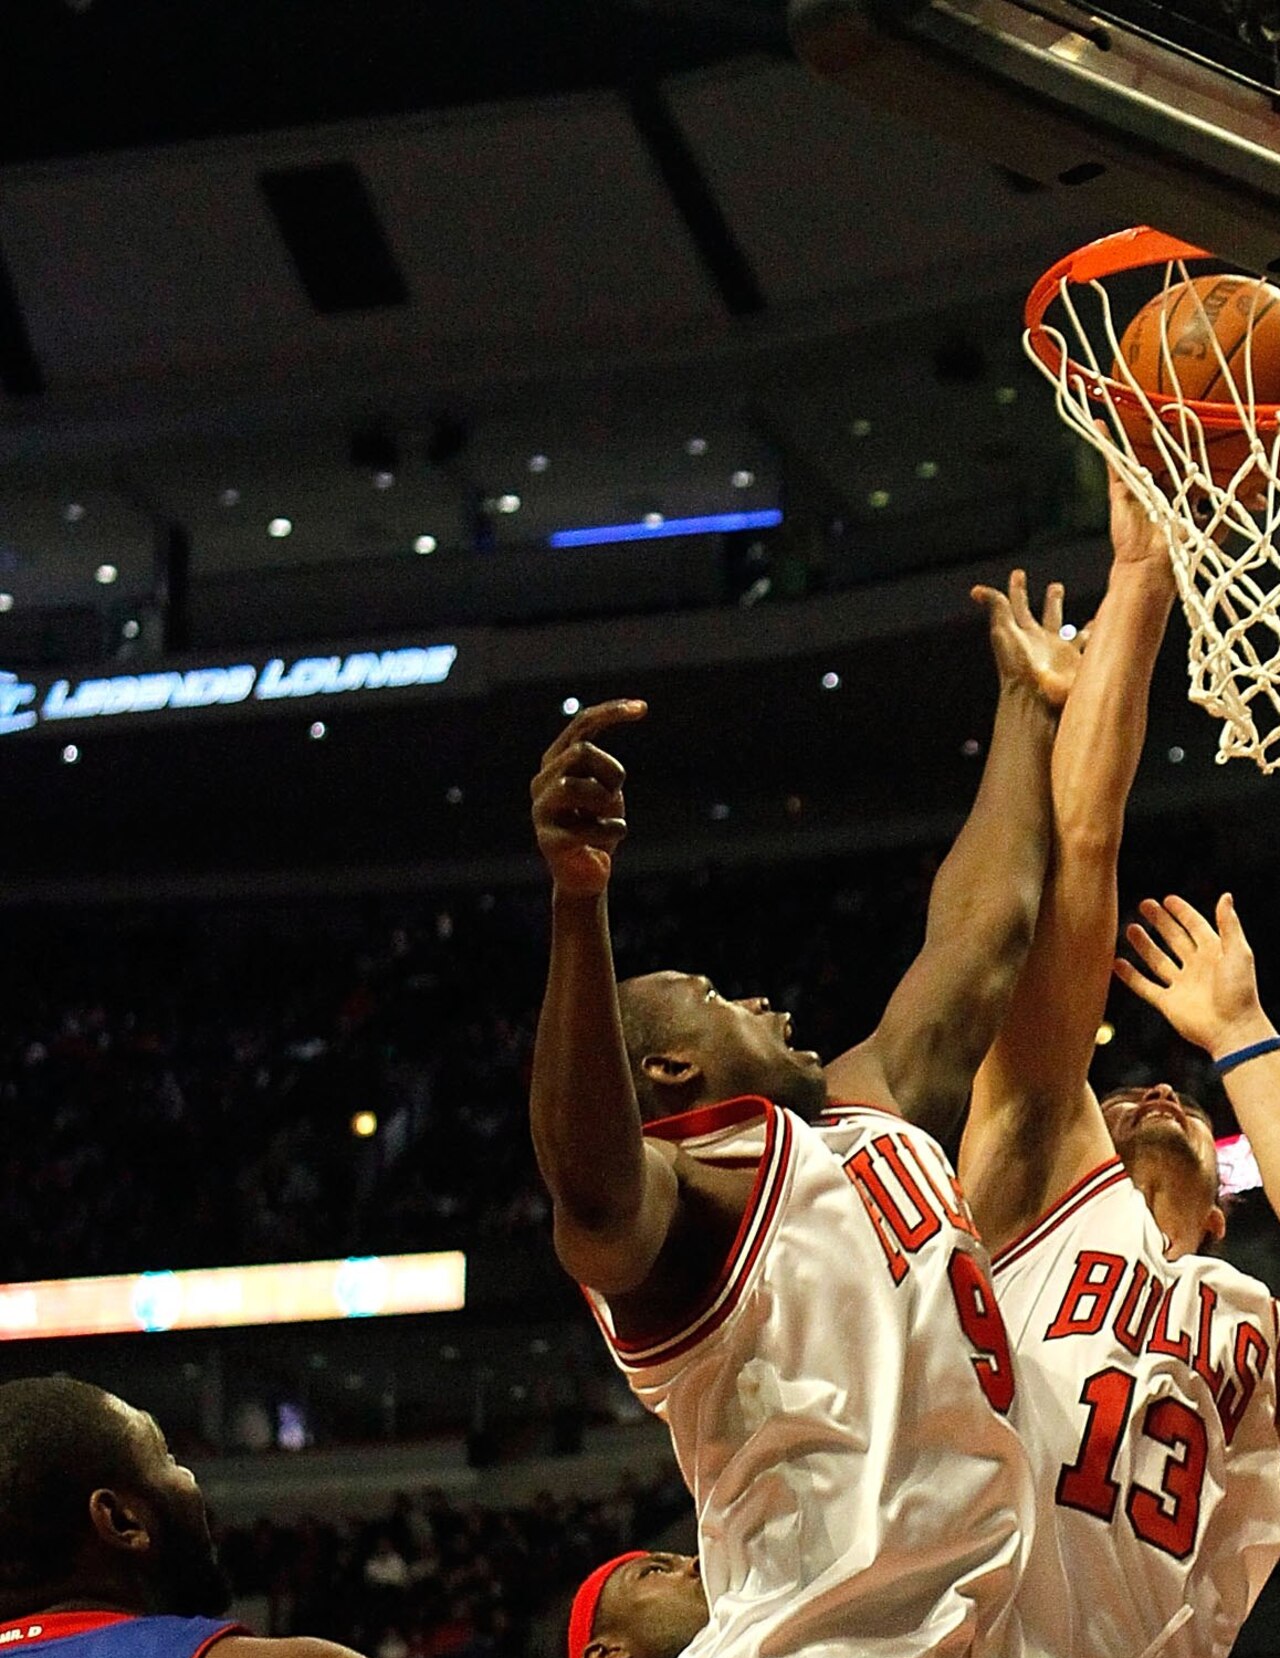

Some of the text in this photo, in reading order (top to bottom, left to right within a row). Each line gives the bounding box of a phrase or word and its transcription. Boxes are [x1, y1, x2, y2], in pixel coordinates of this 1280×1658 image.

[946, 1246, 1015, 1417] 9
[1045, 1250, 1269, 1447] BULLS
[1055, 1365, 1210, 1560] 13
[27, 1625, 43, 1638] D
